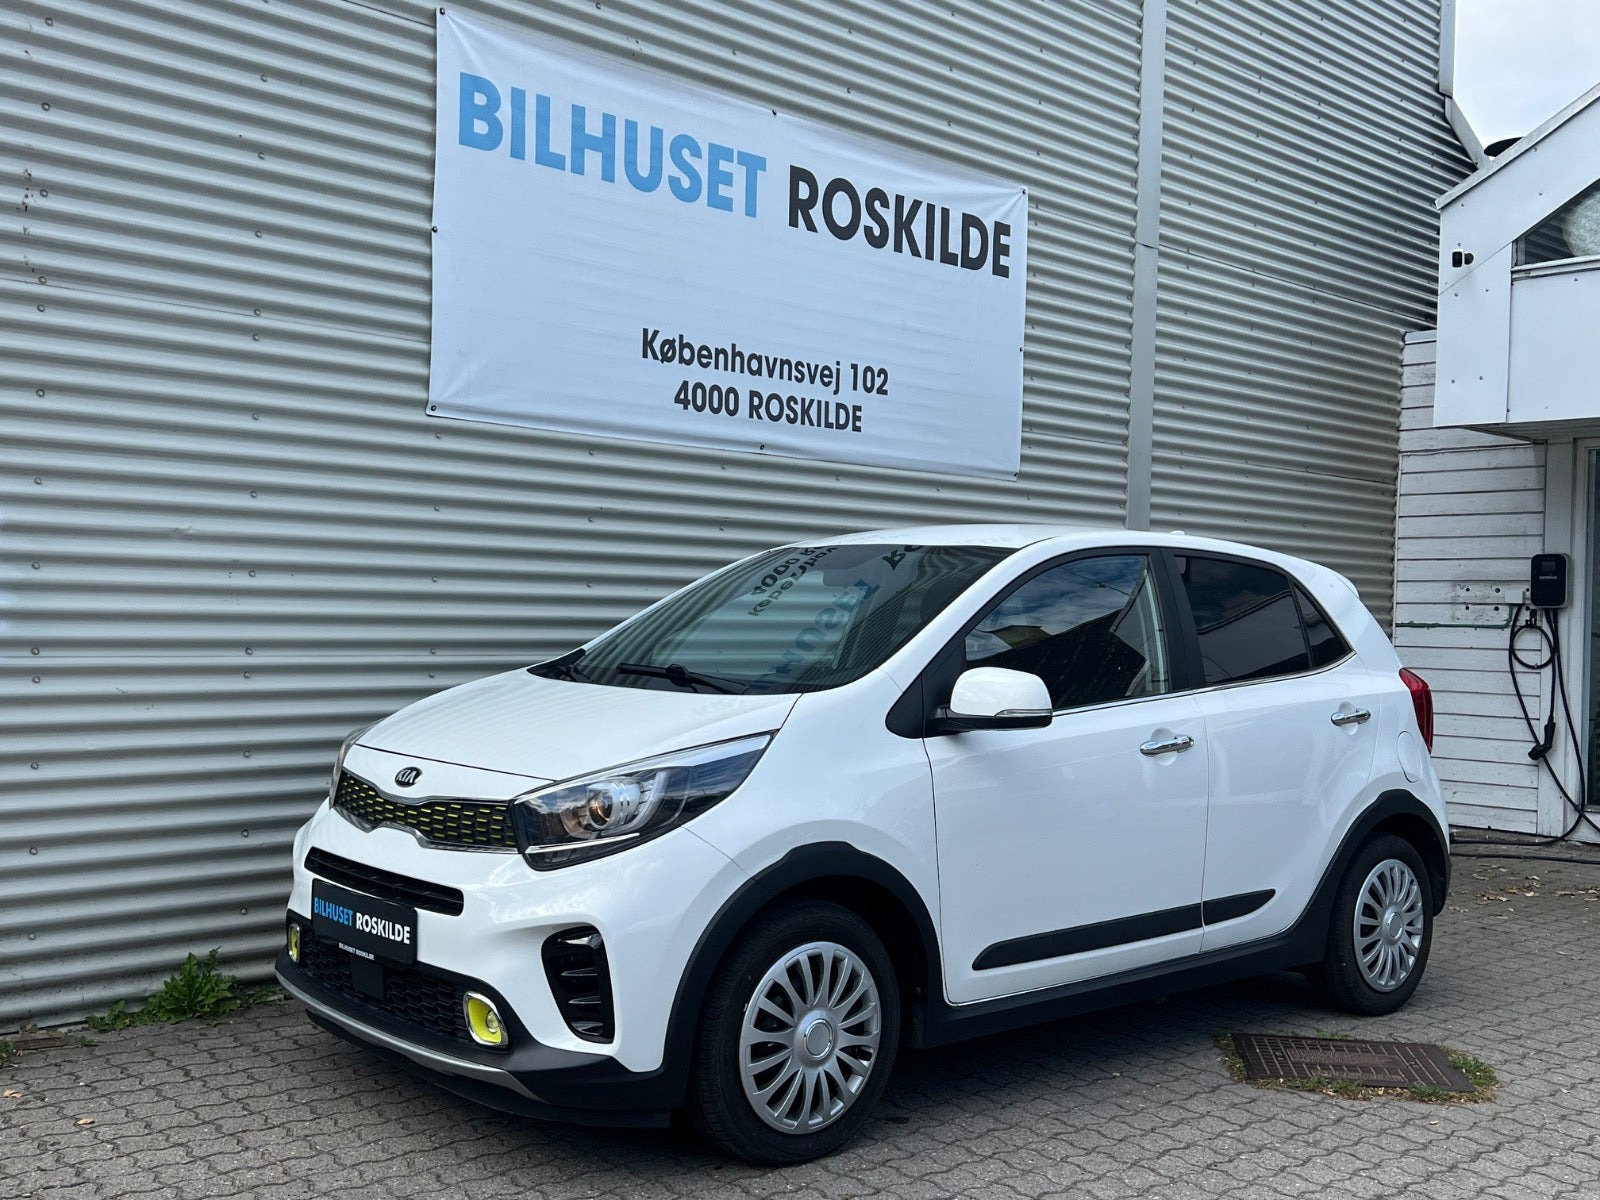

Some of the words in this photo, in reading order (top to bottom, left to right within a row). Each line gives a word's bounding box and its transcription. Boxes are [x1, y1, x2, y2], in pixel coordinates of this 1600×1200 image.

[458, 71, 767, 219] BILHUSET
[788, 165, 1012, 279] ROSKILDE
[641, 327, 841, 396] Københavnsvej
[850, 363, 889, 396] 102
[673, 380, 740, 417] 4000
[748, 389, 863, 433] ROSKILDE
[395, 769, 417, 784] KIA
[314, 896, 354, 927] BILHUSET
[355, 911, 411, 945] ROSKILDE
